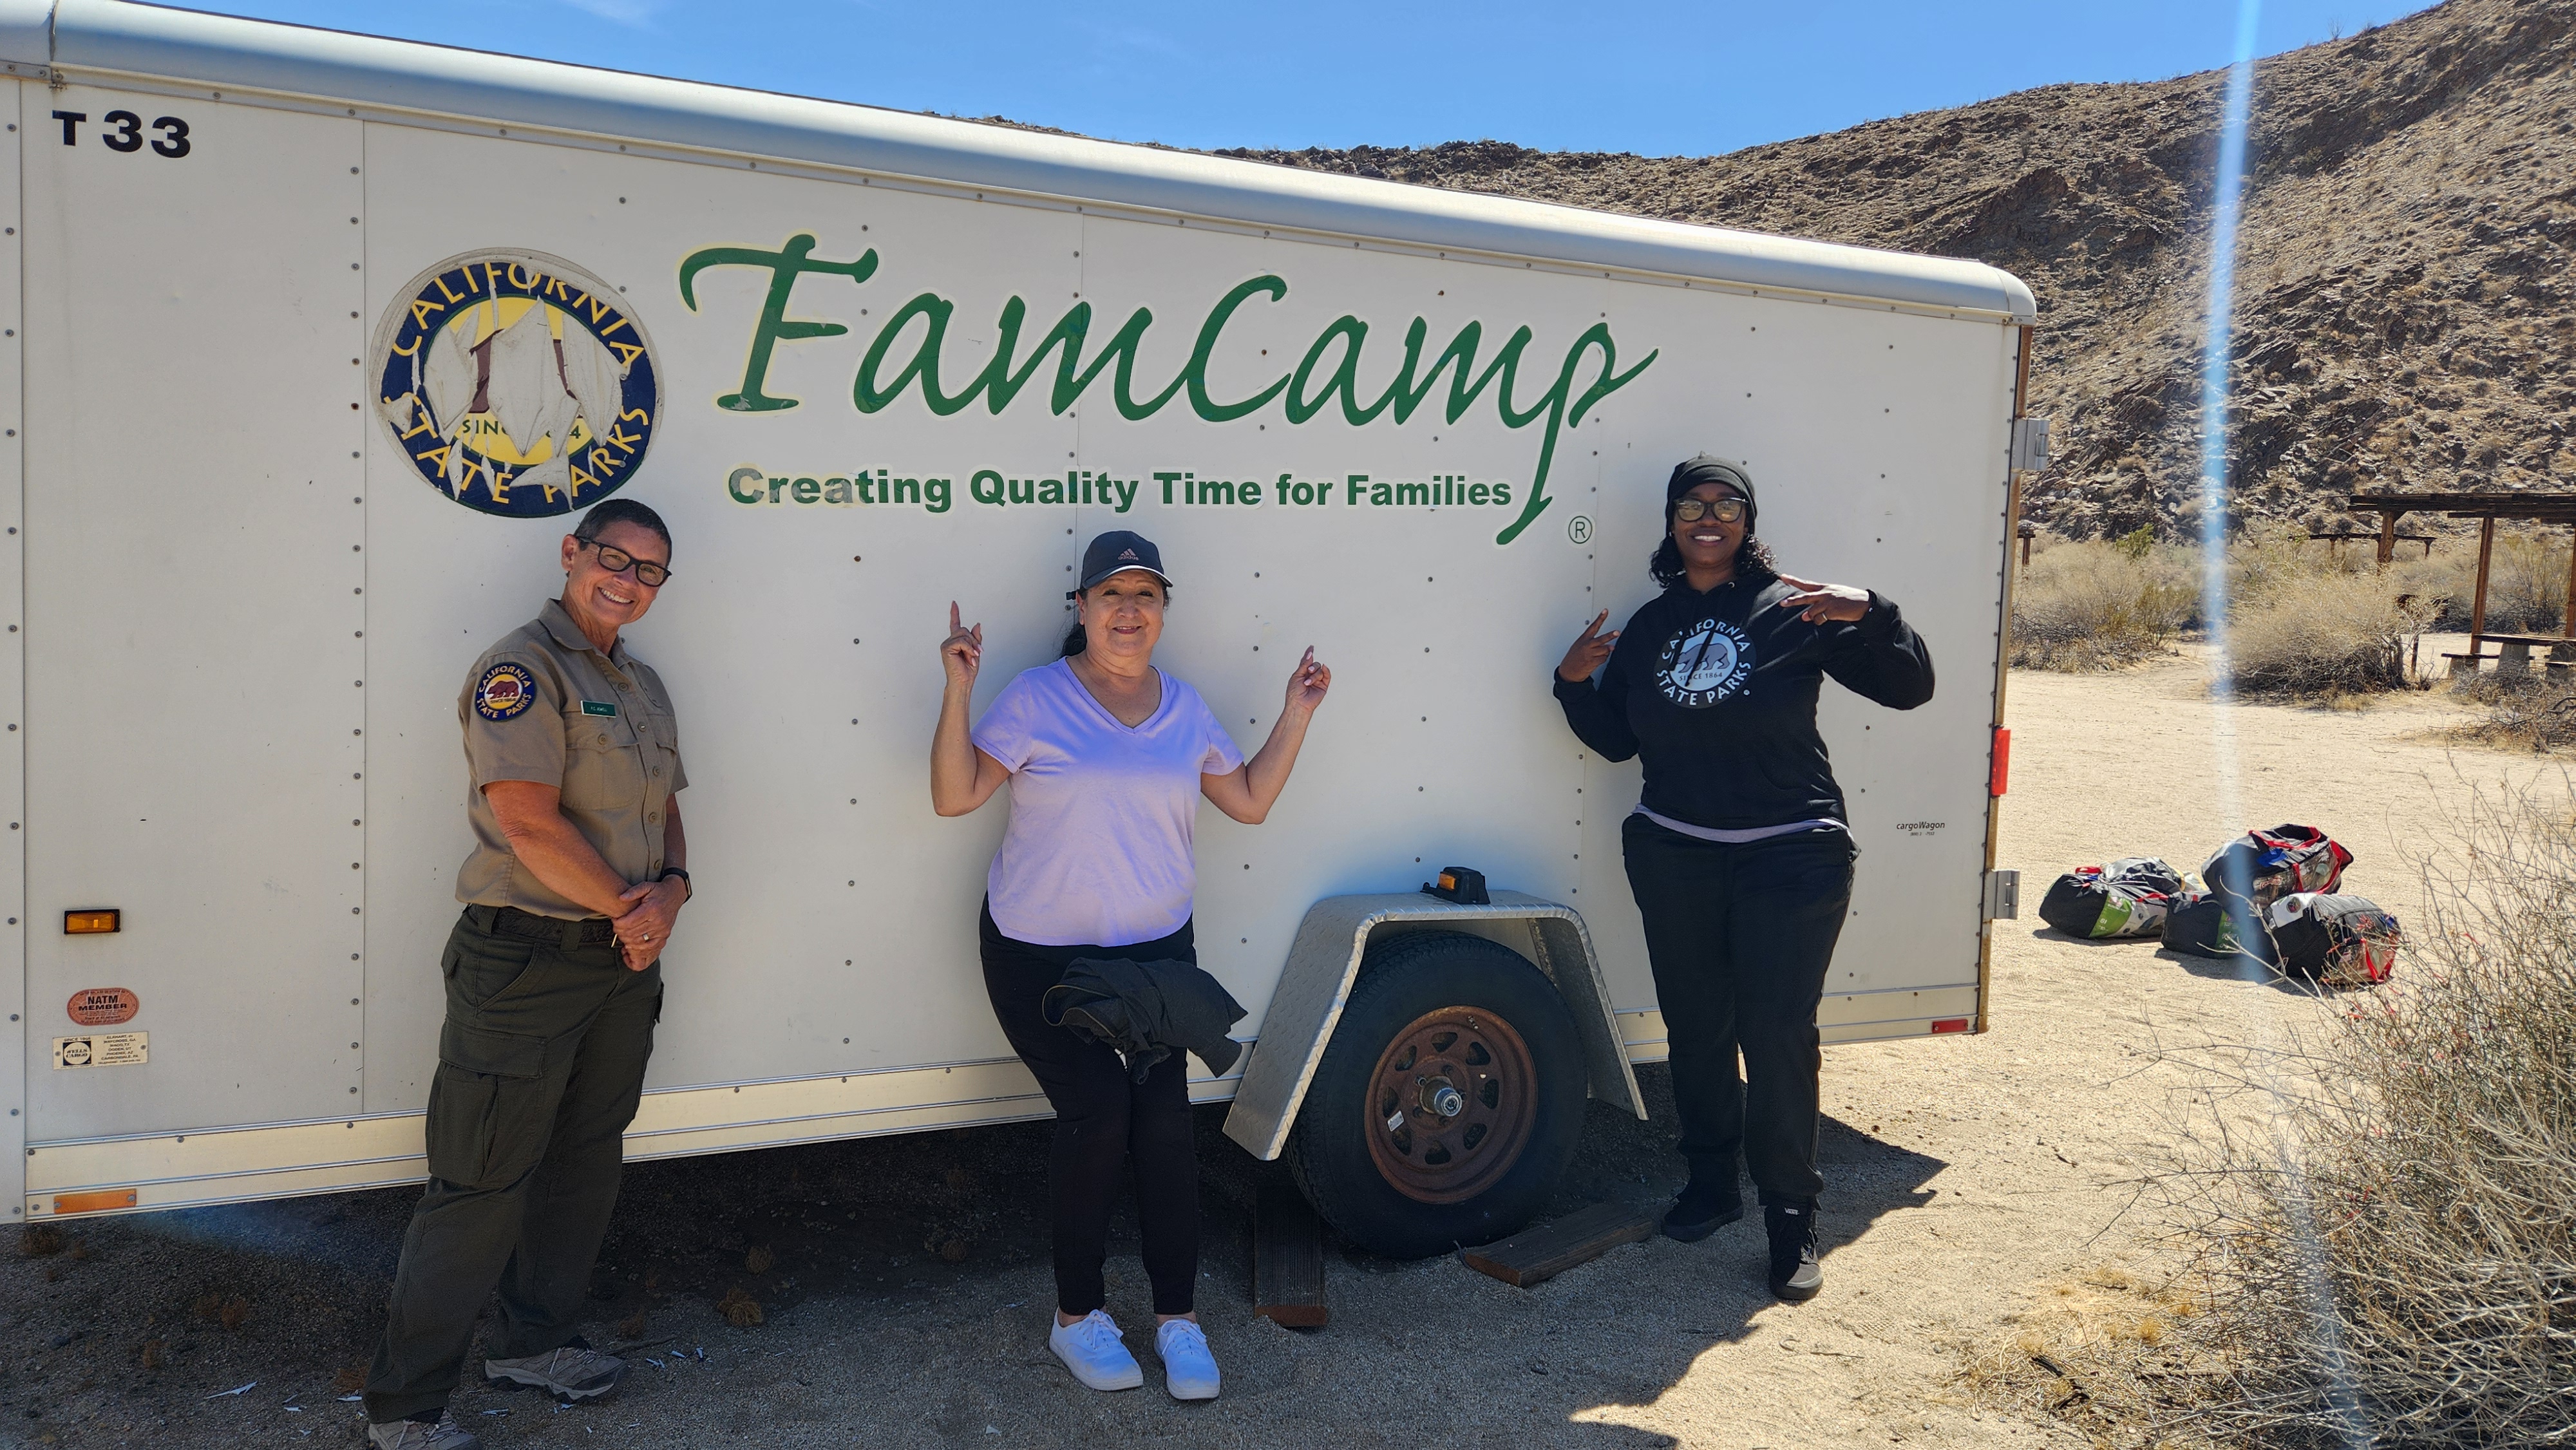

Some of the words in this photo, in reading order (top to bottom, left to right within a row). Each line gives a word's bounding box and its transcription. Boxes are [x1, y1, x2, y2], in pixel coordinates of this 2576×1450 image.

[679, 234, 1659, 545] FamCamp
[728, 469, 951, 514] Creating
[970, 469, 1139, 513] Quality
[1153, 472, 1262, 505] Time
[1276, 473, 1333, 505] for
[1347, 475, 1511, 506] Families
[1662, 619, 1751, 661] CAIFORNIA
[478, 665, 532, 693] CALIFORNIA
[1656, 670, 1698, 706] STATE
[1706, 662, 1751, 704] PARKS
[1680, 673, 1702, 681] SICE
[477, 697, 499, 719] STATE
[506, 693, 532, 717] PARKS
[1896, 821, 1946, 831] cargoWagon
[88, 995, 118, 1004] NATM
